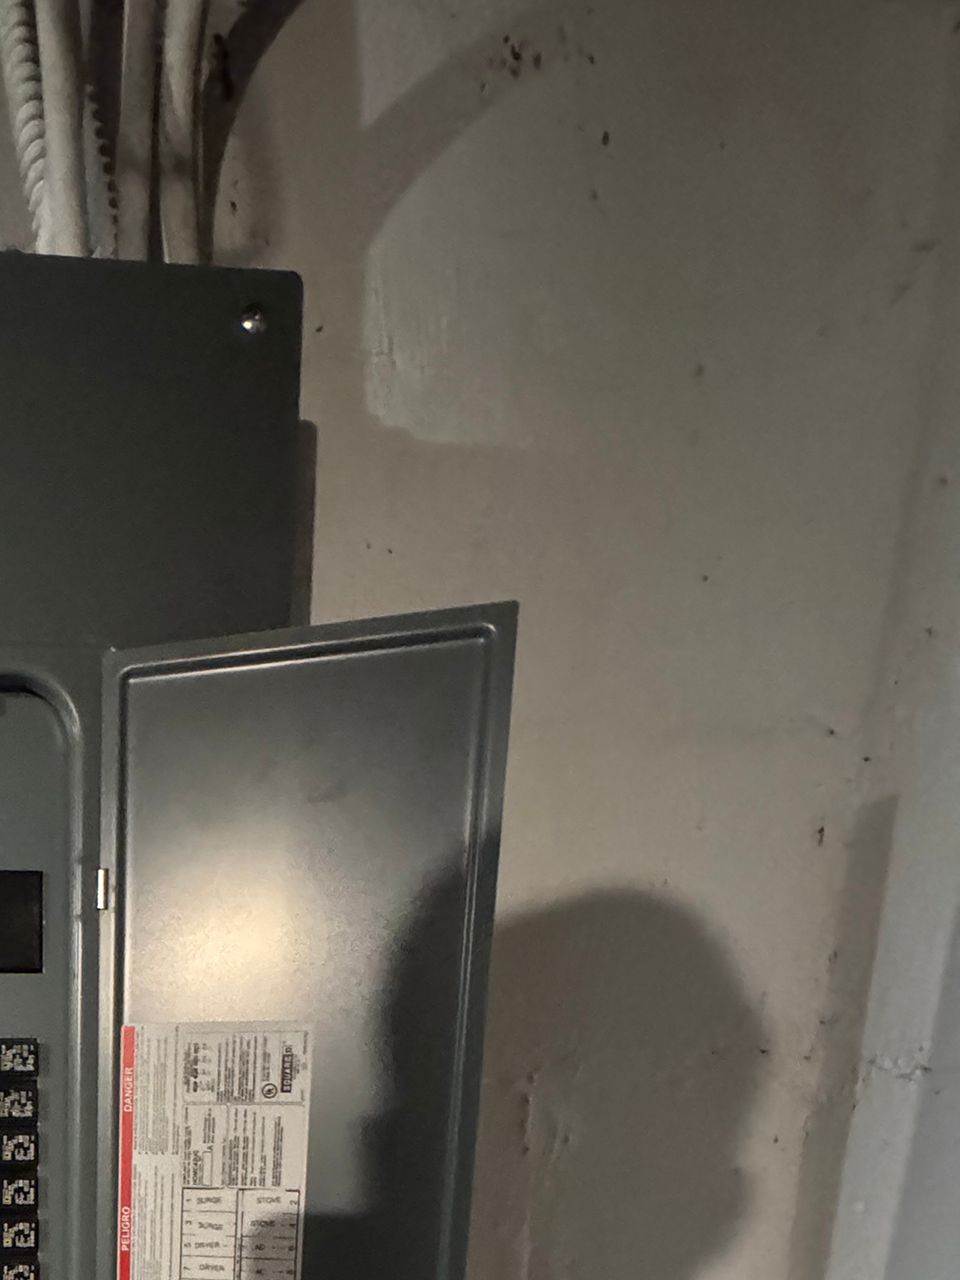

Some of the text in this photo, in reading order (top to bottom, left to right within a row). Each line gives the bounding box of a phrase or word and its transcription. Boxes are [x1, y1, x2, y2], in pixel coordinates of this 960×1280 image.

[282, 1054, 292, 1092] SQUARE
[124, 1067, 134, 1112] DANGER
[196, 1197, 222, 1205] SURGE
[198, 1222, 223, 1230] SURGE
[250, 1220, 275, 1228] STOVE
[121, 1206, 130, 1251] PELIGRO
[199, 1264, 225, 1272] DRYER
